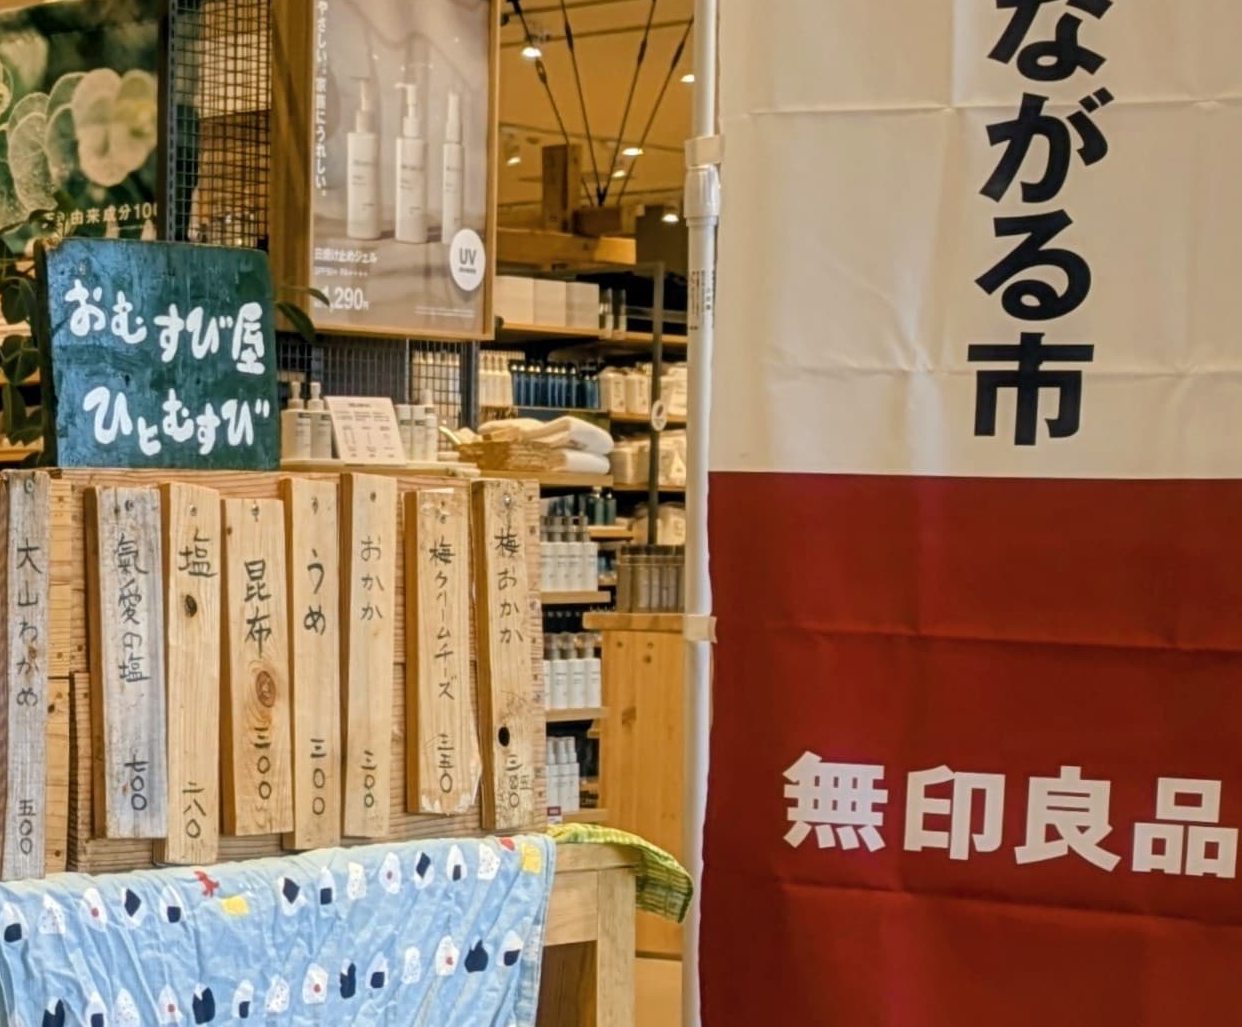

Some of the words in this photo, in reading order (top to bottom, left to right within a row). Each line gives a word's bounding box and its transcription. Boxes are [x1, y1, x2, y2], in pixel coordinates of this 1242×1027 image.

[459, 248, 477, 265] UV
[65, 278, 265, 375] おむすび屋
[83, 386, 270, 456] ひとむすび
[178, 529, 218, 578] 塩
[303, 548, 326, 636] うめ
[360, 535, 385, 621] おかか
[494, 527, 524, 645] 梅おかか
[16, 540, 43, 707] 大山わかめ
[244, 559, 272, 657] 昆布
[428, 539, 457, 700] 梅クリームチーズ
[781, 750, 1240, 878] 無印良品
